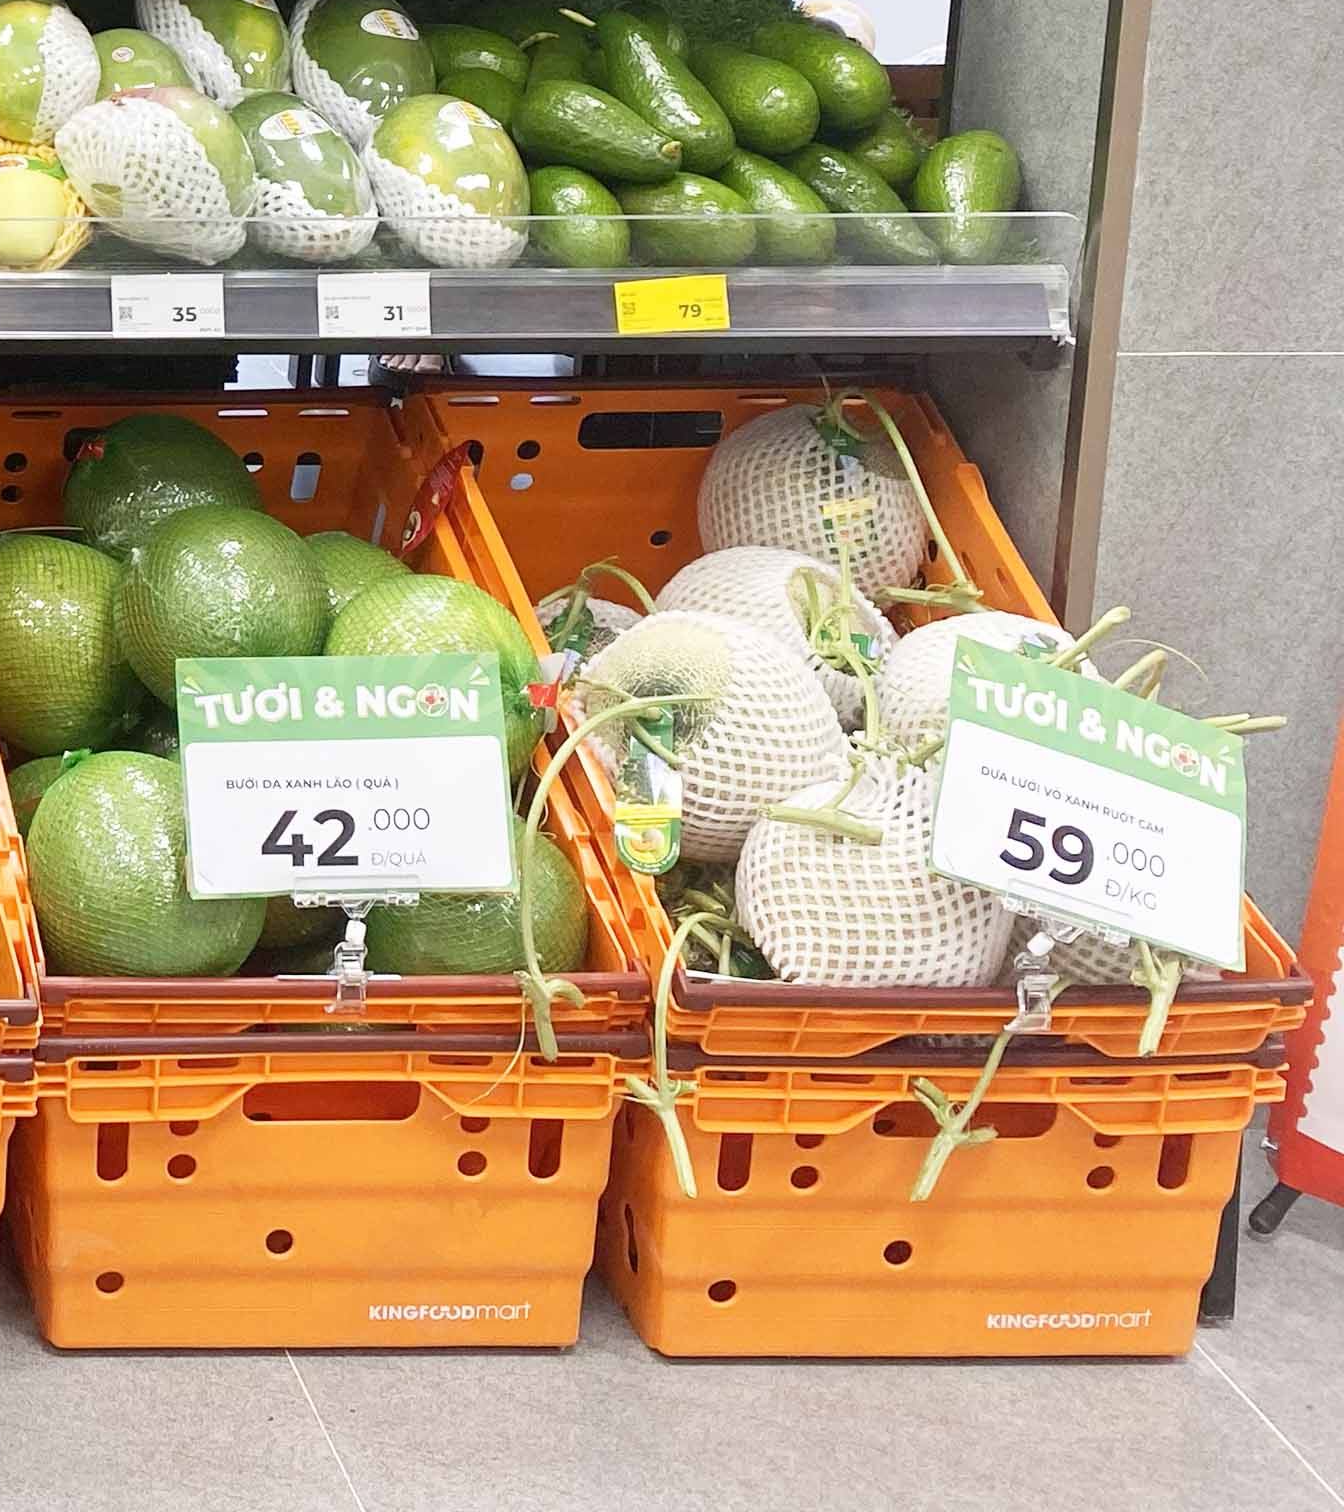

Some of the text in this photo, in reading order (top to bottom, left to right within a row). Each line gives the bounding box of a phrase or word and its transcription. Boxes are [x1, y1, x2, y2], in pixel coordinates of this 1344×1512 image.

[172, 307, 197, 322] 35
[383, 306, 404, 321] 31
[678, 304, 701, 319] 79
[194, 682, 480, 728] TƯƠI & NGON
[968, 676, 1228, 797] TƯƠI & NGON
[263, 779, 283, 790] DA
[285, 779, 322, 790] XANH
[1064, 794, 1100, 813] XANH
[261, 809, 359, 867] 42
[1000, 808, 1095, 885] 59
[369, 1300, 531, 1321] KINGFOODmart
[987, 1308, 1152, 1330] KINGFOODmart
